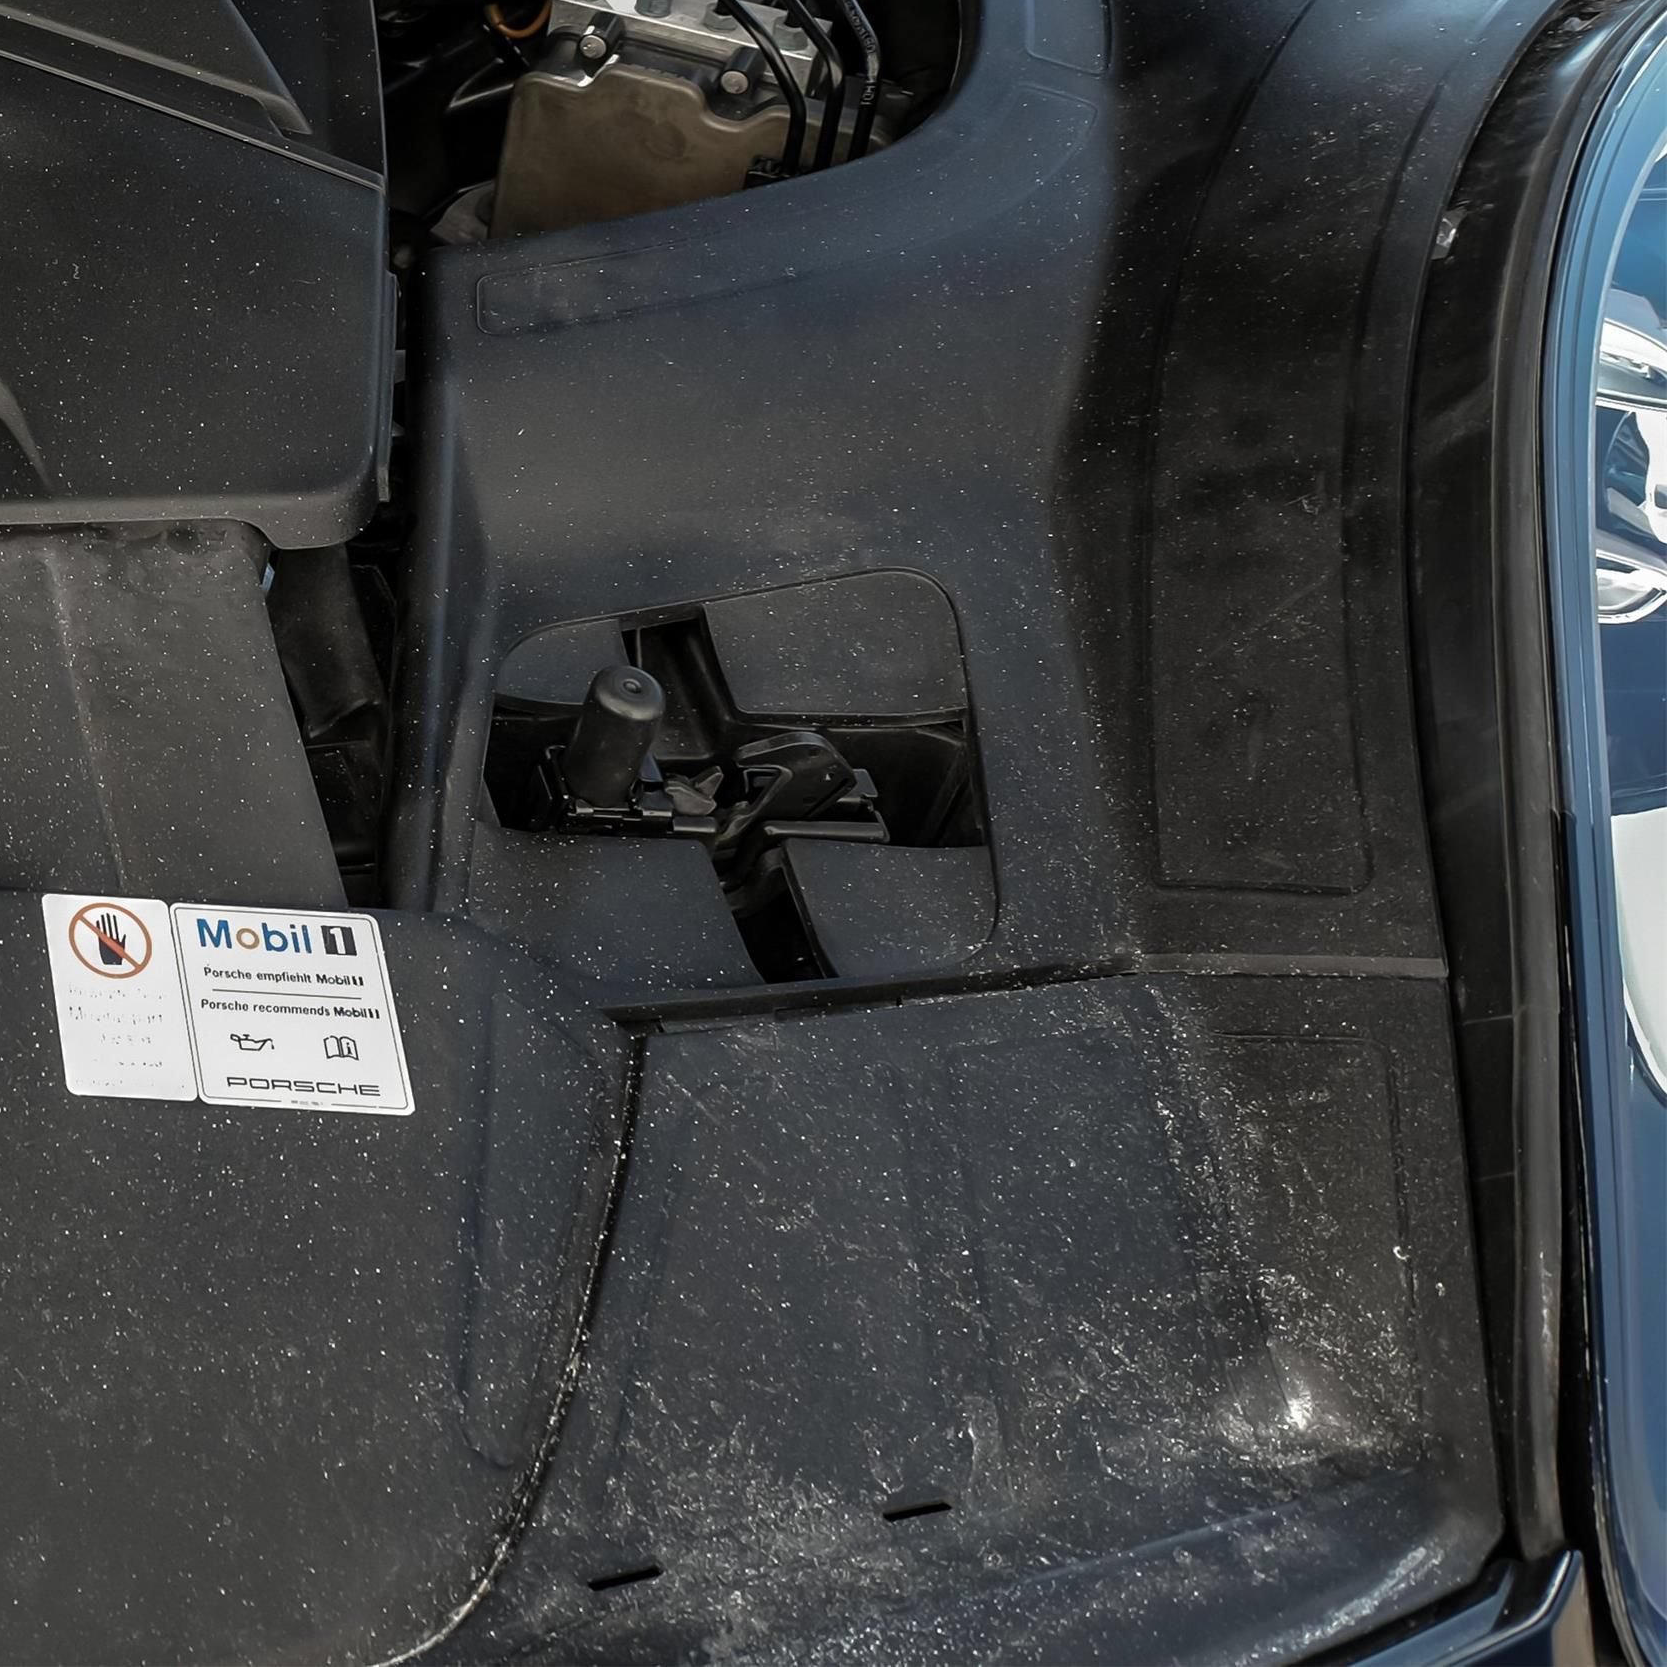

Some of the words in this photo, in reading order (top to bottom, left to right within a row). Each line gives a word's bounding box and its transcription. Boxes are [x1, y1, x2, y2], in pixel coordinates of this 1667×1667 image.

[196, 918, 312, 954] Mobil
[323, 926, 354, 956] 1
[204, 966, 252, 981] Porsche
[256, 971, 312, 984] empfiehlt
[317, 974, 350, 986] Mobil
[201, 998, 249, 1012] Porsche
[253, 1003, 330, 1017] recommends
[334, 1007, 367, 1018] Mobil
[226, 1076, 381, 1097] PORSCHE
